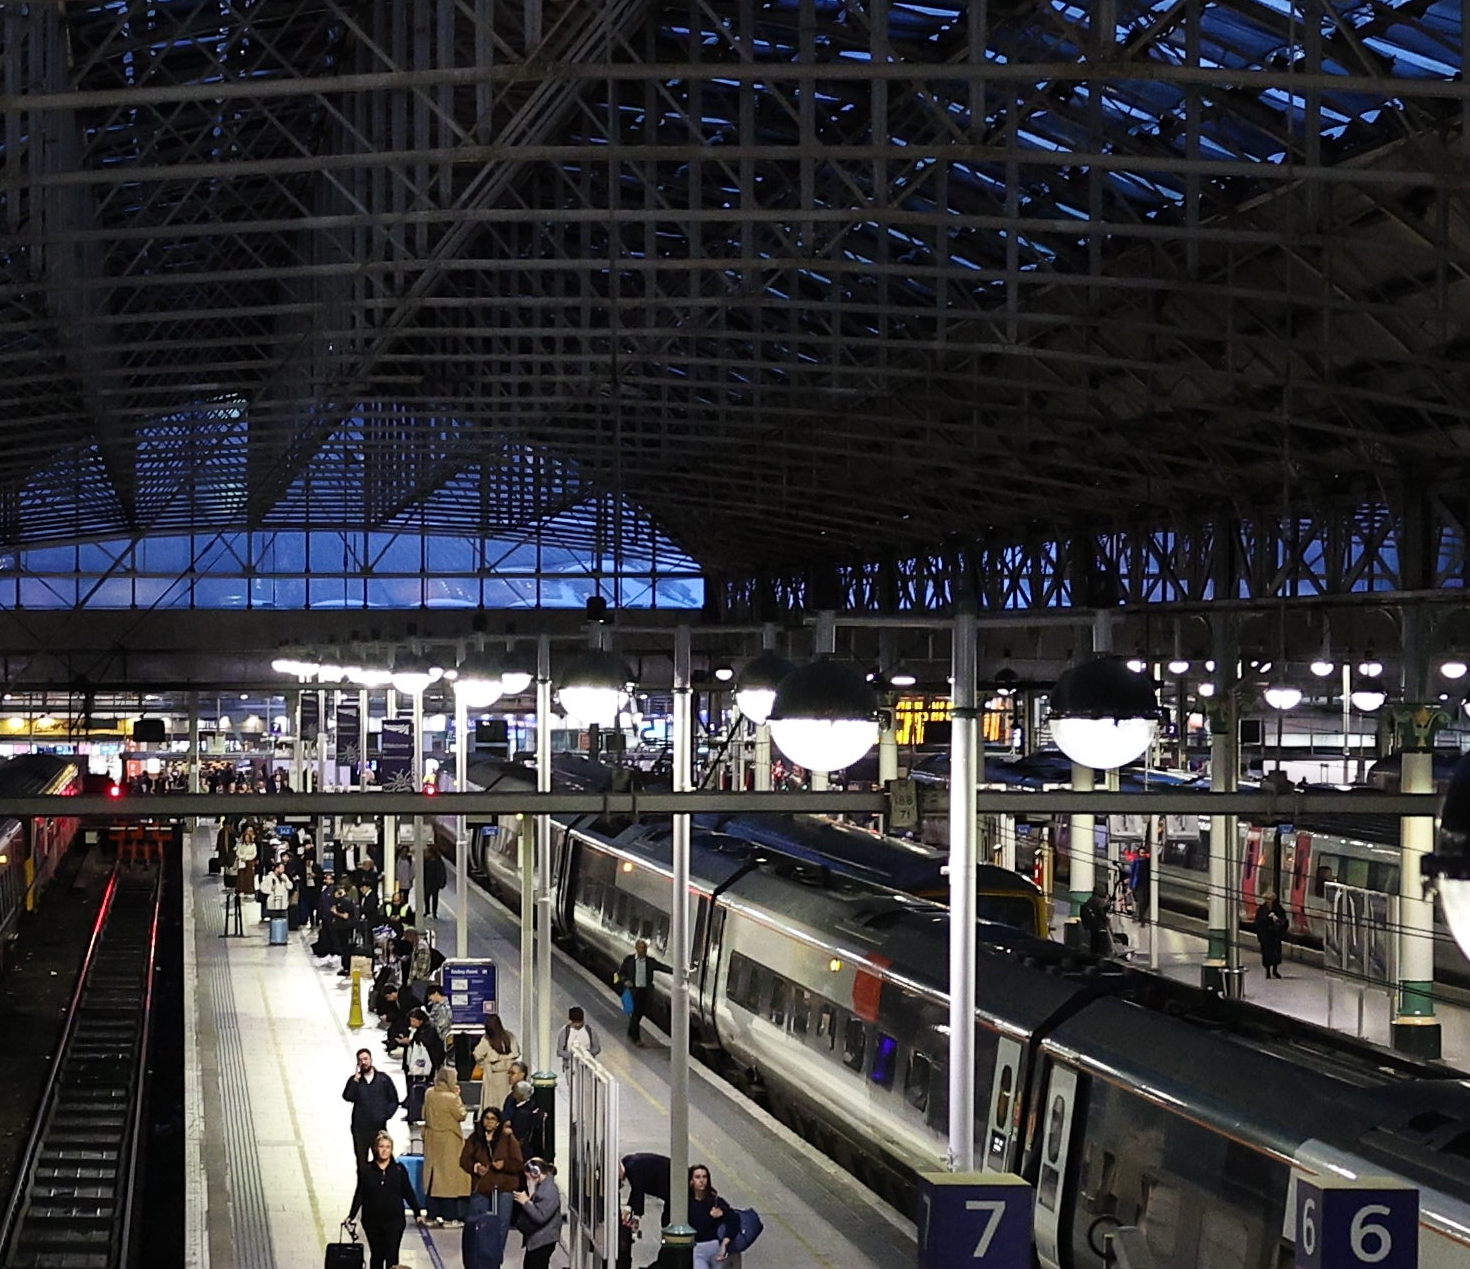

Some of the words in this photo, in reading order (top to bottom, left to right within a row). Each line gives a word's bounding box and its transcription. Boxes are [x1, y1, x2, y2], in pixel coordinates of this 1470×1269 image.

[964, 1199, 1008, 1258] 7
[1301, 1196, 1317, 1257] 6
[1348, 1204, 1392, 1263] 6
